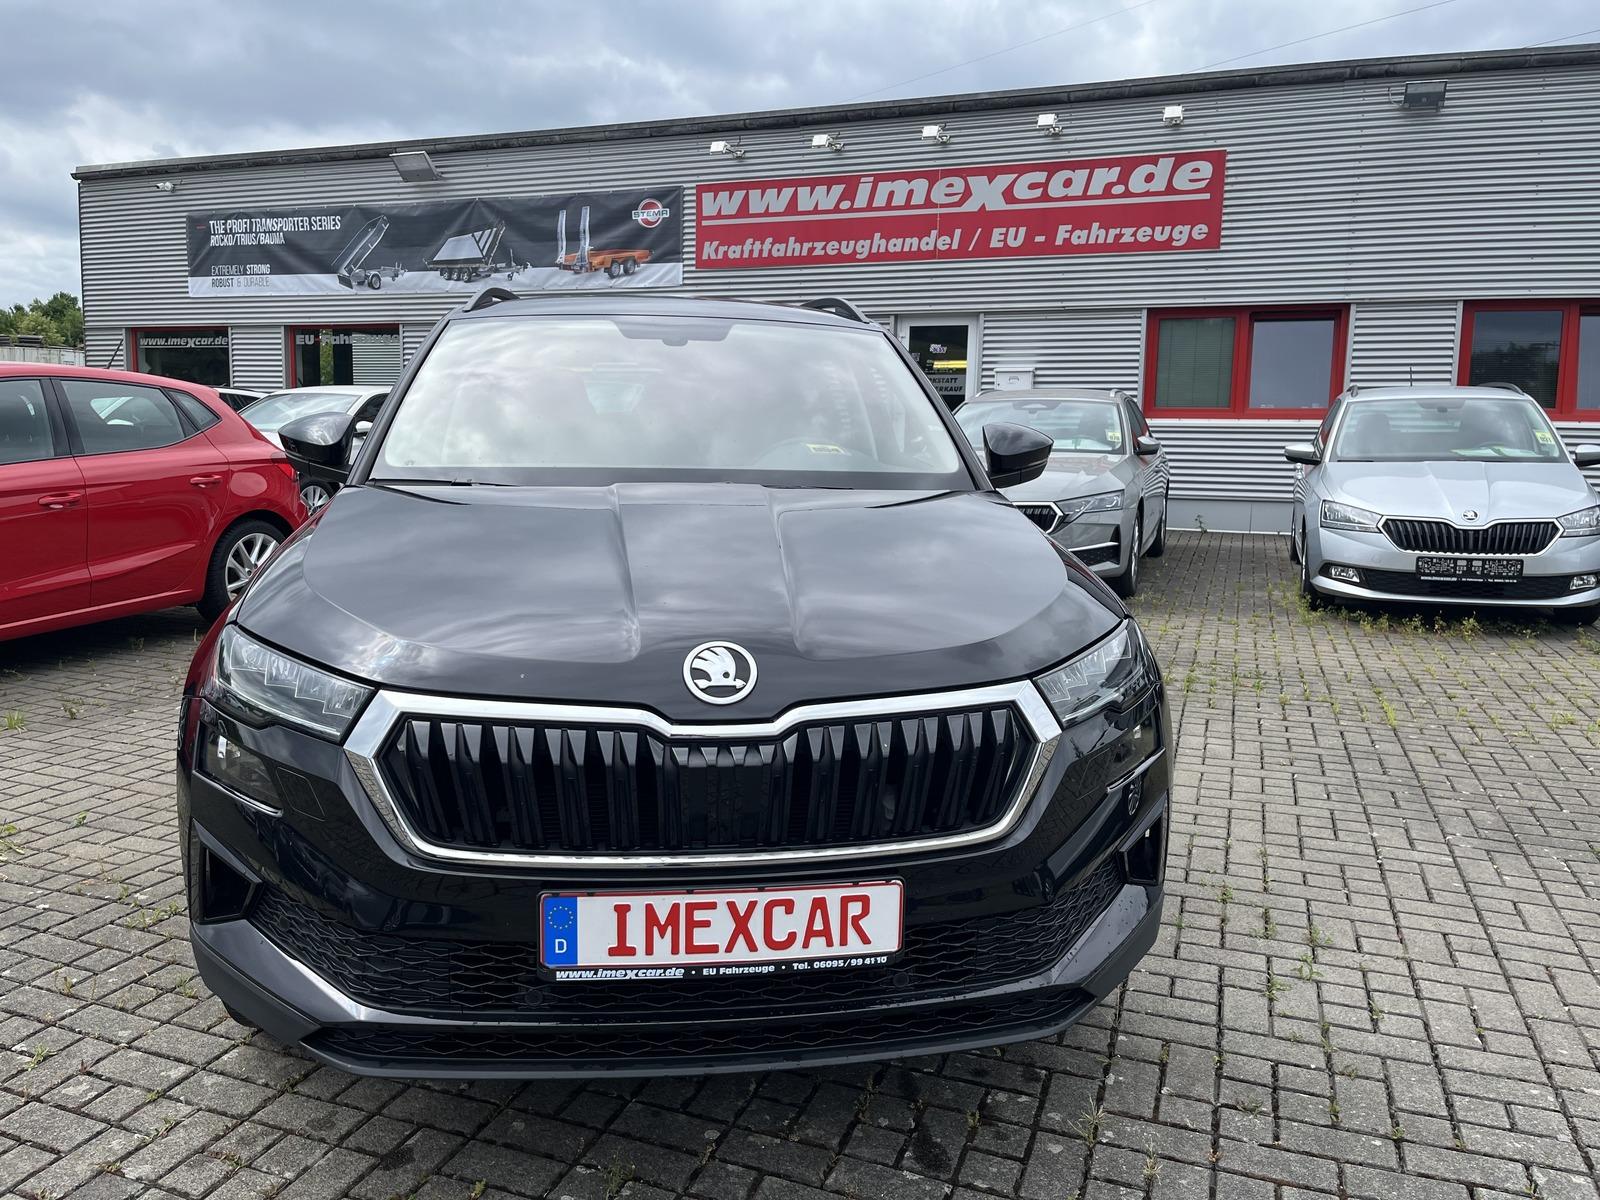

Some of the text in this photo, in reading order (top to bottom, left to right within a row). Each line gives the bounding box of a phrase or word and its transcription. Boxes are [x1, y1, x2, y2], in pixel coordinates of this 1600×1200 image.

[633, 209, 668, 218] STEMA
[209, 215, 341, 234] THE PROFI TRANSPORTER SERIES
[210, 232, 285, 247] ROCKO/TRIUS/BAUMA
[702, 229, 960, 260] Kraftfahrzeughandel
[989, 226, 1026, 249] EU
[1055, 222, 1209, 249] Fahrzeuge
[211, 263, 271, 276] EXTREMELY STRONG
[211, 277, 234, 288] ROBUST
[243, 276, 270, 287] DURABLE
[607, 894, 871, 956] IMEXCAR
[554, 938, 567, 954] D
[703, 967, 716, 976] EU
[719, 964, 775, 976] Fahrzeuge
[792, 962, 811, 970] Tel.
